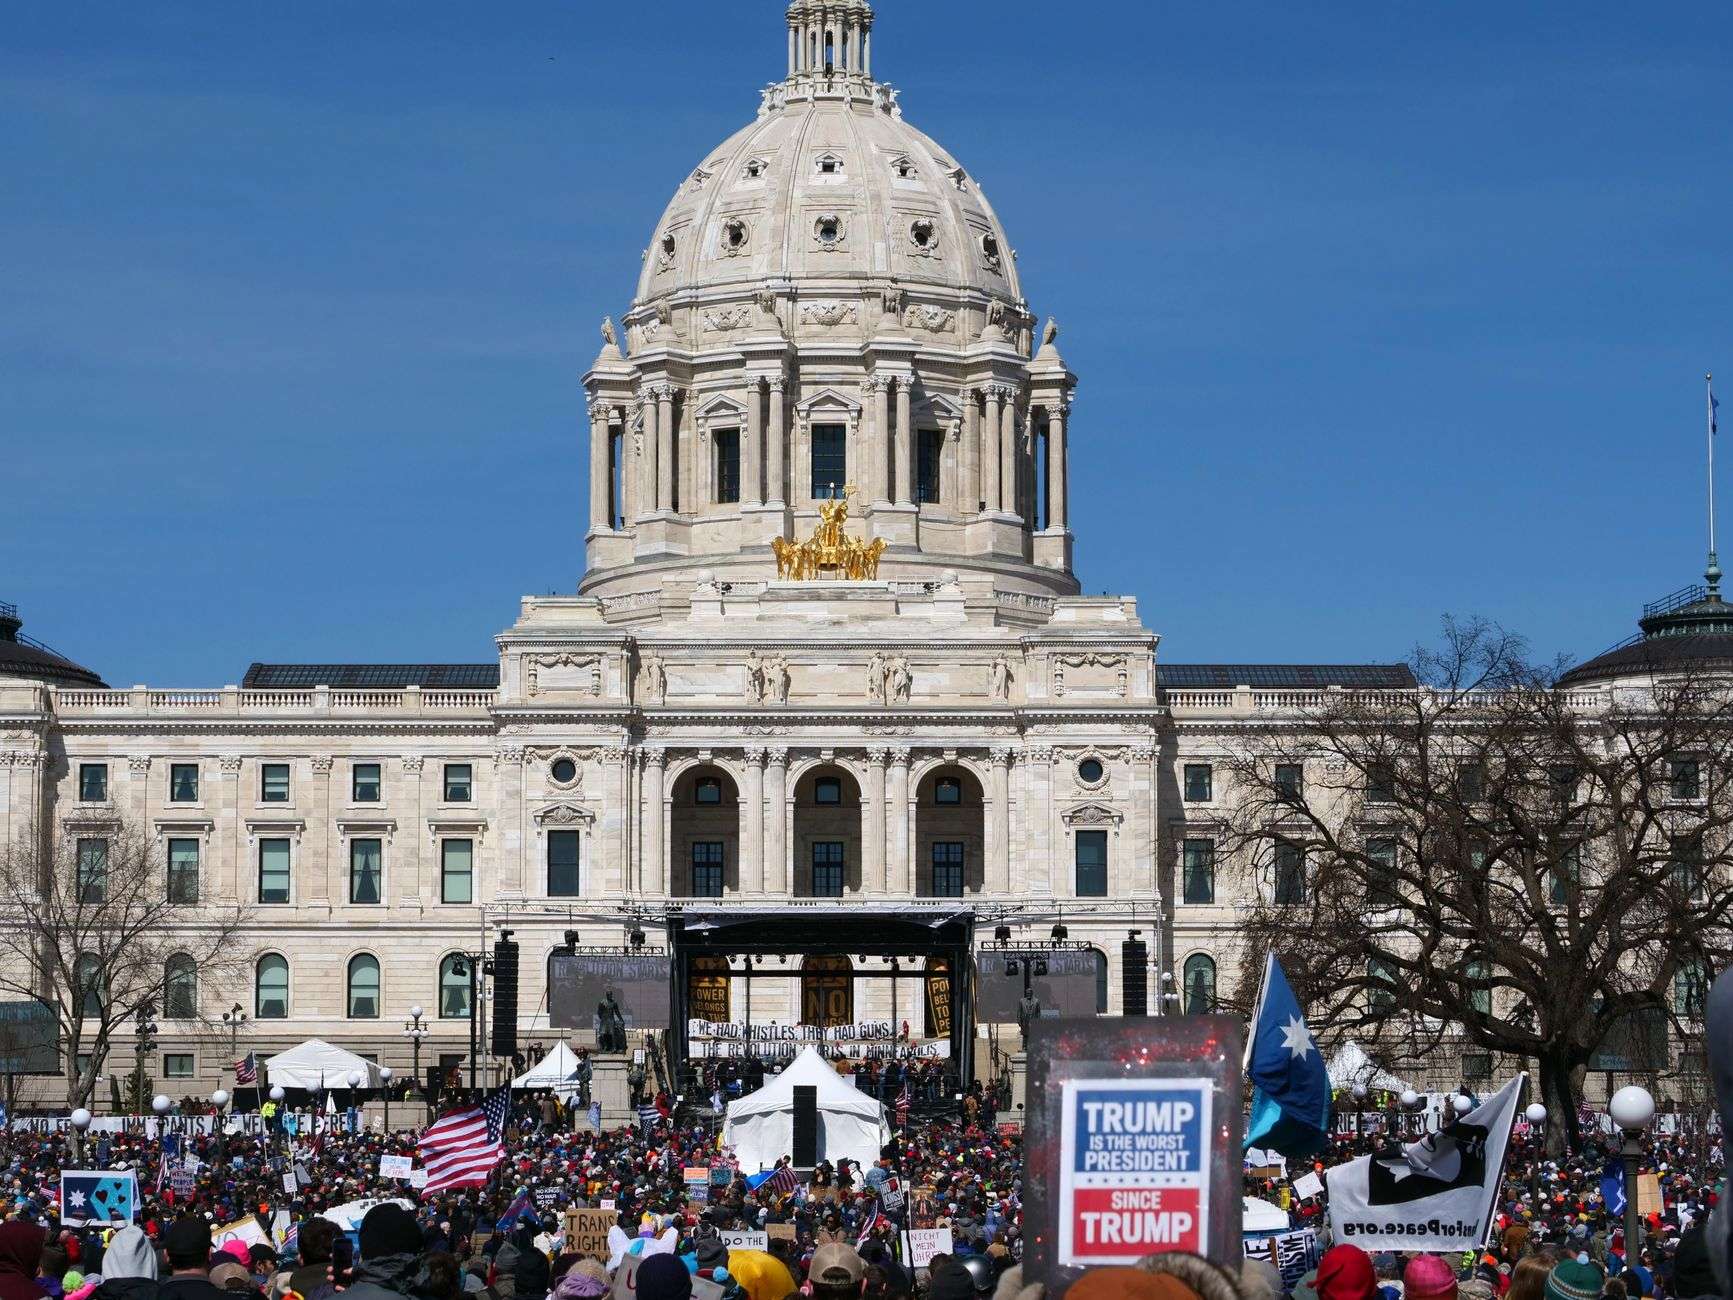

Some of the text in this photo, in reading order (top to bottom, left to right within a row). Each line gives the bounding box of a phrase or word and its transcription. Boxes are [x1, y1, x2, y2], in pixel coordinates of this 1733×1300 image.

[692, 988, 725, 1000] OWER
[699, 1021, 712, 1035] WE
[803, 1025, 828, 1040] THEY
[834, 1026, 855, 1039] HAD
[703, 1042, 722, 1057] THE
[849, 1045, 859, 1058] IN
[1083, 1101, 1194, 1133] TRUMP
[1089, 1134, 1185, 1150] IS THE WORST
[1085, 1150, 1190, 1171] PRESIDENT
[1111, 1190, 1162, 1210] SINCE
[567, 1214, 614, 1232] TRANS
[1080, 1211, 1192, 1244] TRUMP
[566, 1235, 608, 1251] RIGHT
[724, 1236, 764, 1247] DO THE
[911, 1231, 940, 1241] NICHT
[916, 1241, 936, 1251] MEIN
